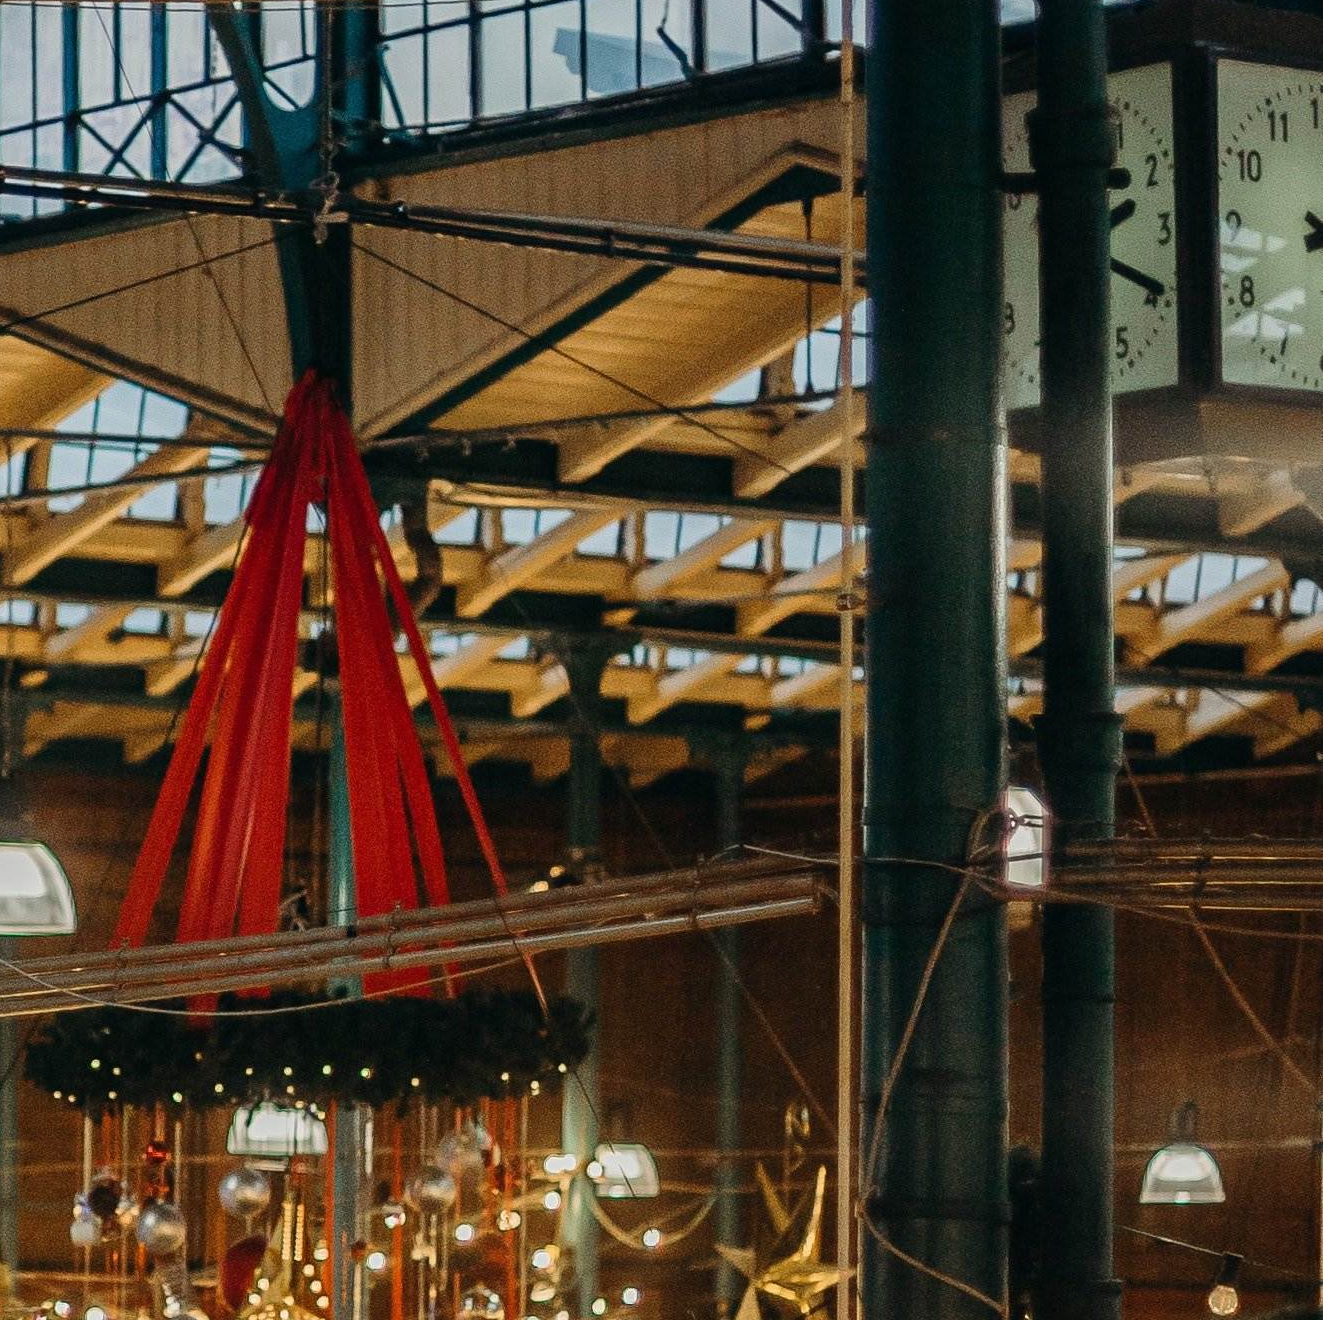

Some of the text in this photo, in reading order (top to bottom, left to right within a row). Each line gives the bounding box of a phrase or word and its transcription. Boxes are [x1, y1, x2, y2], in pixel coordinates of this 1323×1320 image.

[1268, 110, 1288, 142] 11
[1145, 153, 1158, 187] 2
[1237, 149, 1261, 182] 10
[1158, 212, 1171, 246] 3
[1226, 209, 1242, 243] 9
[1240, 274, 1255, 308] 8
[1115, 326, 1129, 359] 5
